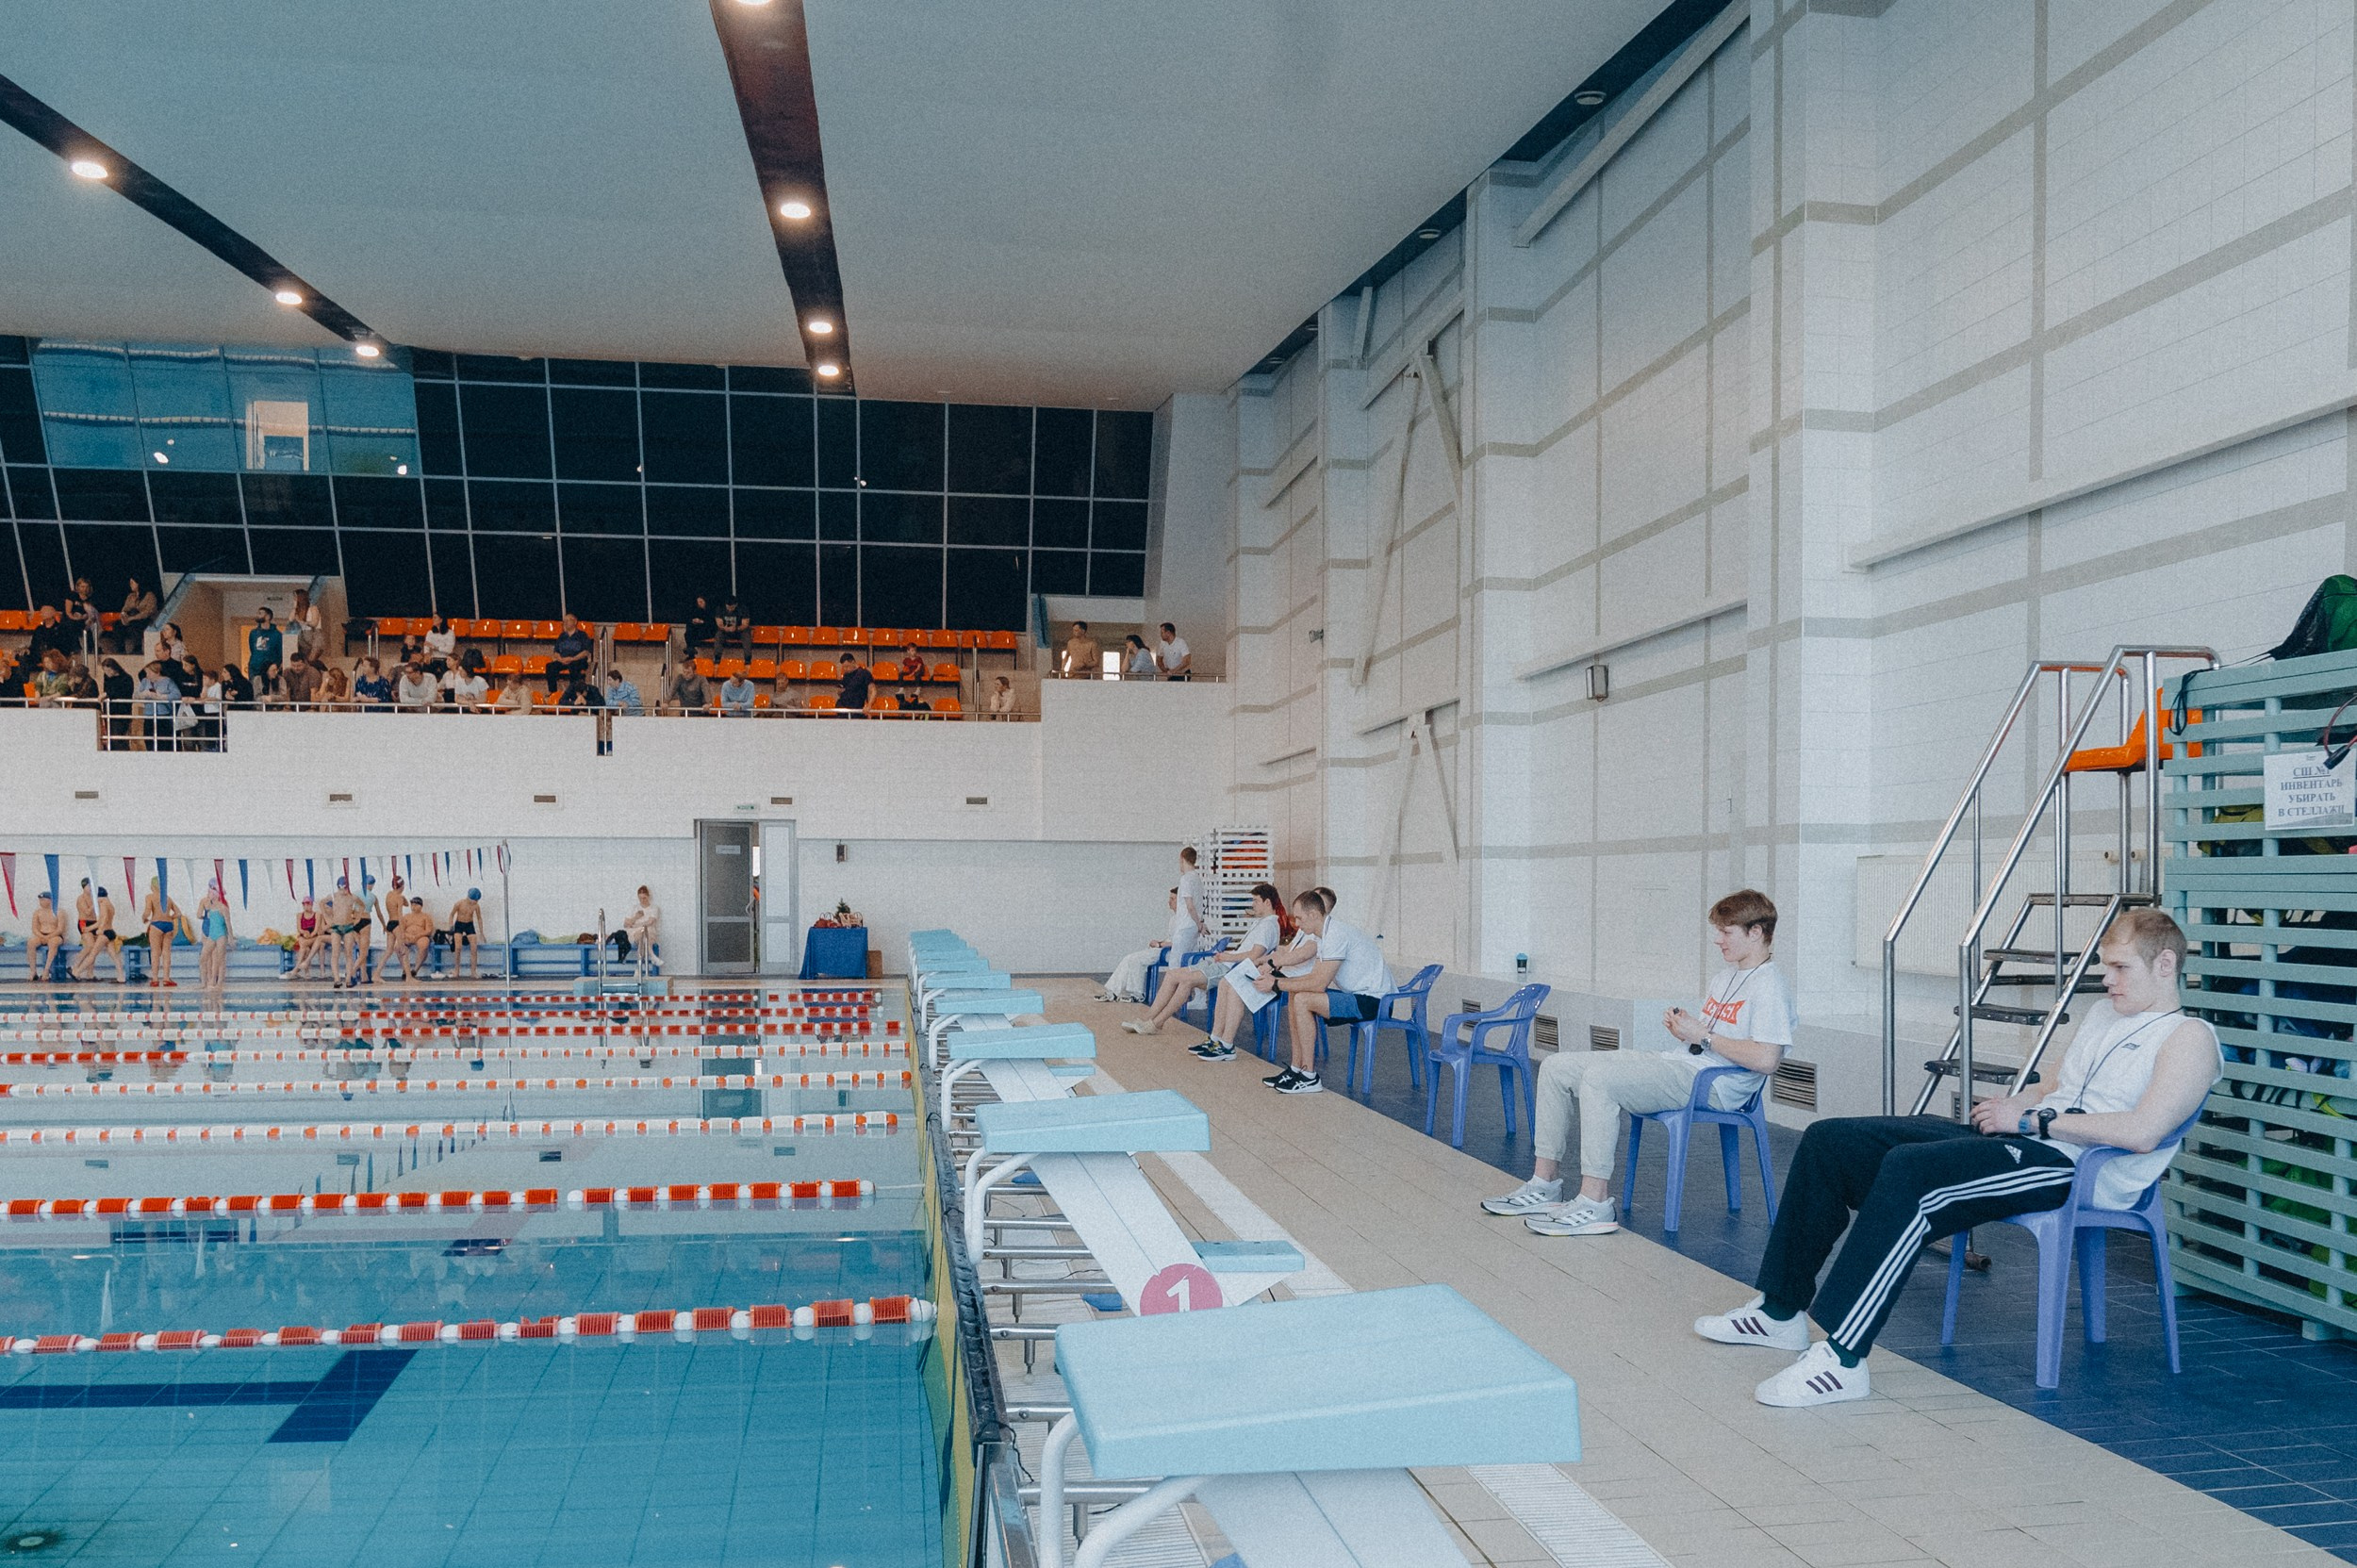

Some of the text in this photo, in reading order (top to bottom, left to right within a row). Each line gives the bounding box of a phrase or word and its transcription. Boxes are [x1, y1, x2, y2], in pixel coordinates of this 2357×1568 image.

[2281, 779, 2343, 790] ИНВЕНТАРЬ
[2288, 793, 2336, 802] УБИРАТЬ
[2278, 808, 2285, 817] В
[1165, 1278, 1191, 1312] 1
